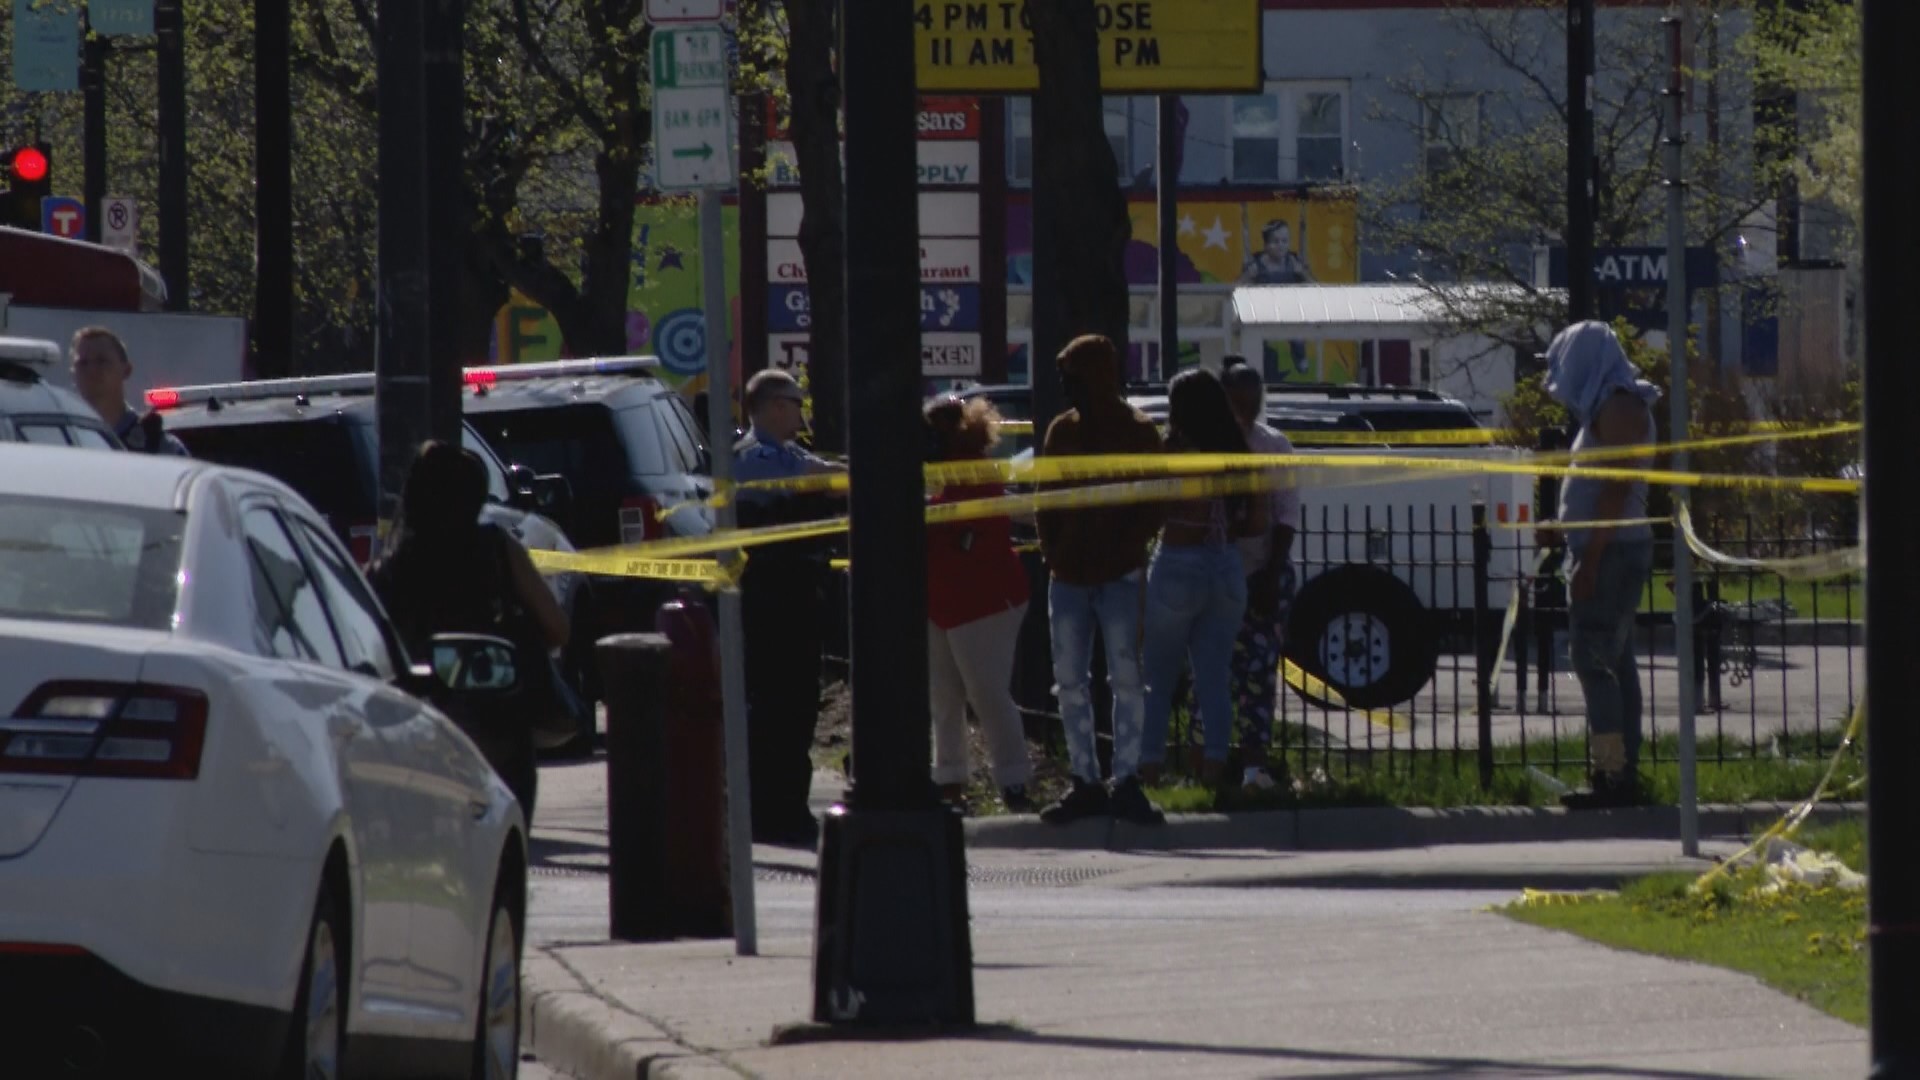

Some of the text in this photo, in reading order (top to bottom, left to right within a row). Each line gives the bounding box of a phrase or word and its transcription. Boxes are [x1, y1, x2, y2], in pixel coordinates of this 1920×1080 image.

[913, 3, 933, 30] 4
[944, 3, 987, 30] PM
[968, 38, 1013, 65] AM
[1114, 38, 1160, 65] PM
[1599, 255, 1668, 280] ATM
